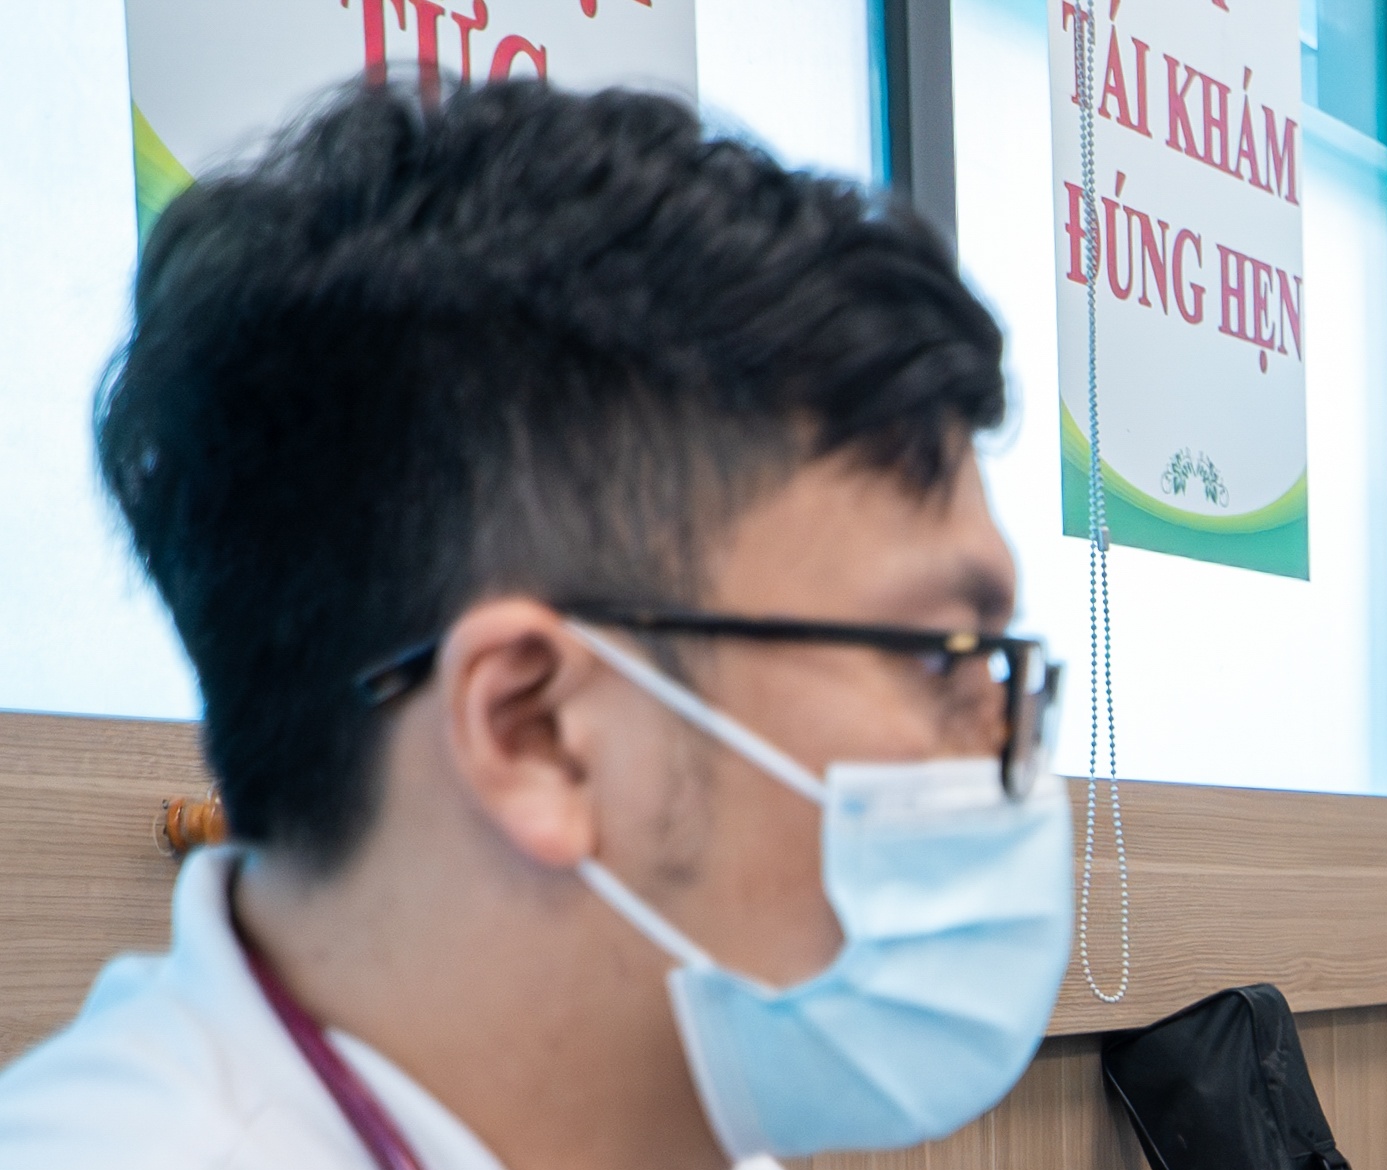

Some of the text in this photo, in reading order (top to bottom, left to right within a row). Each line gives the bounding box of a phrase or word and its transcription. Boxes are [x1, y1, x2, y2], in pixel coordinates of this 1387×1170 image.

[1162, 53, 1300, 207] KHÁM
[1063, 170, 1302, 375] ĐÚNG HẸN
